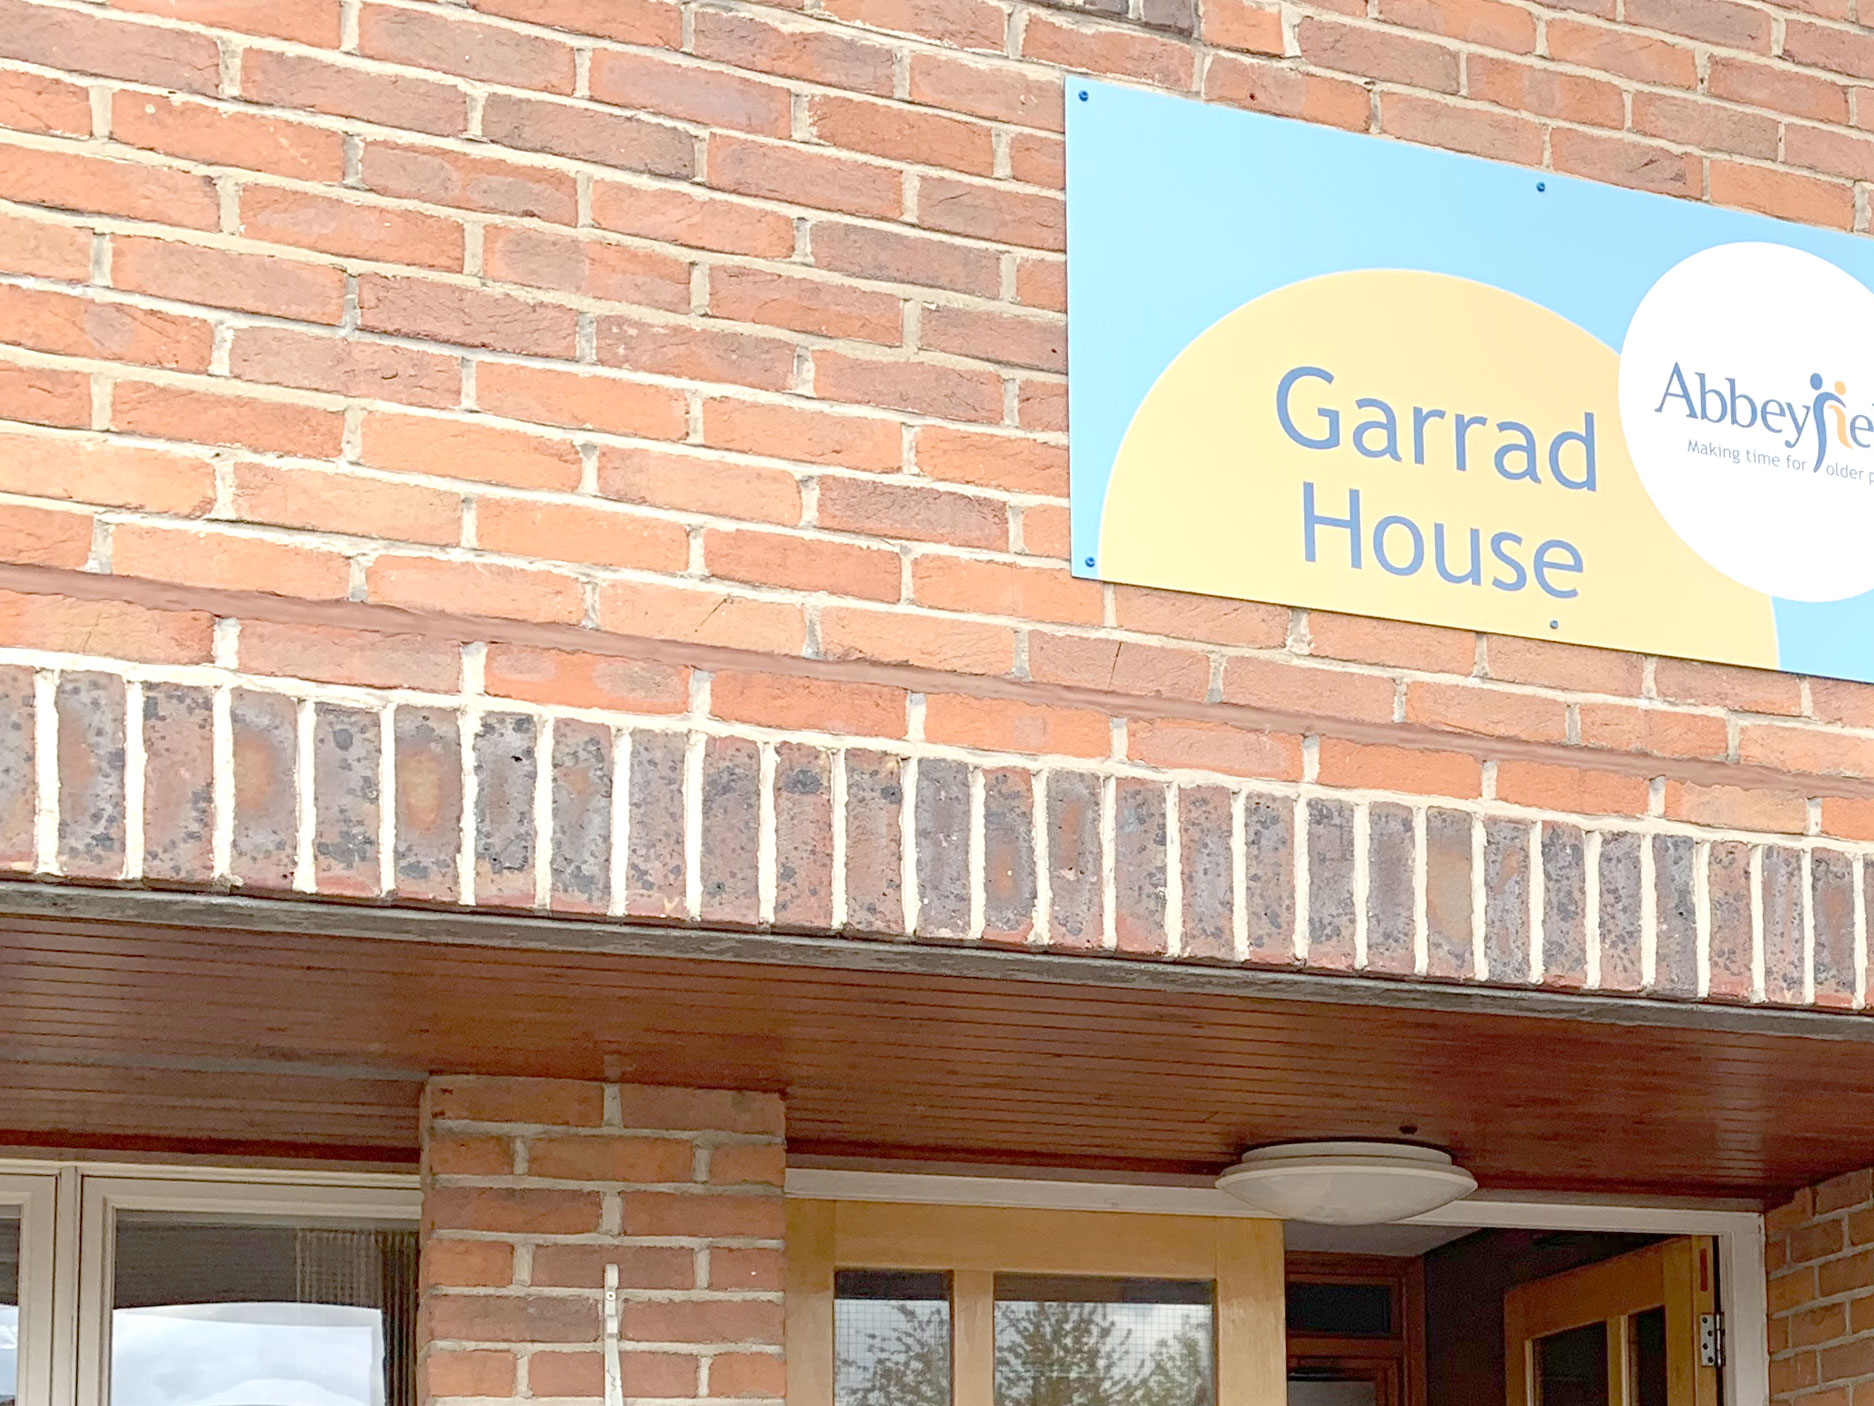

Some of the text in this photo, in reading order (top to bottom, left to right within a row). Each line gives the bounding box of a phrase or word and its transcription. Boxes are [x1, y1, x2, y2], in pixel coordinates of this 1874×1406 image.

[1276, 366, 1597, 492] Garrad
[1687, 439, 1741, 464] Making
[1746, 448, 1781, 467] time
[1785, 455, 1807, 471] for
[1826, 462, 1864, 481] older
[1303, 481, 1584, 599] House
